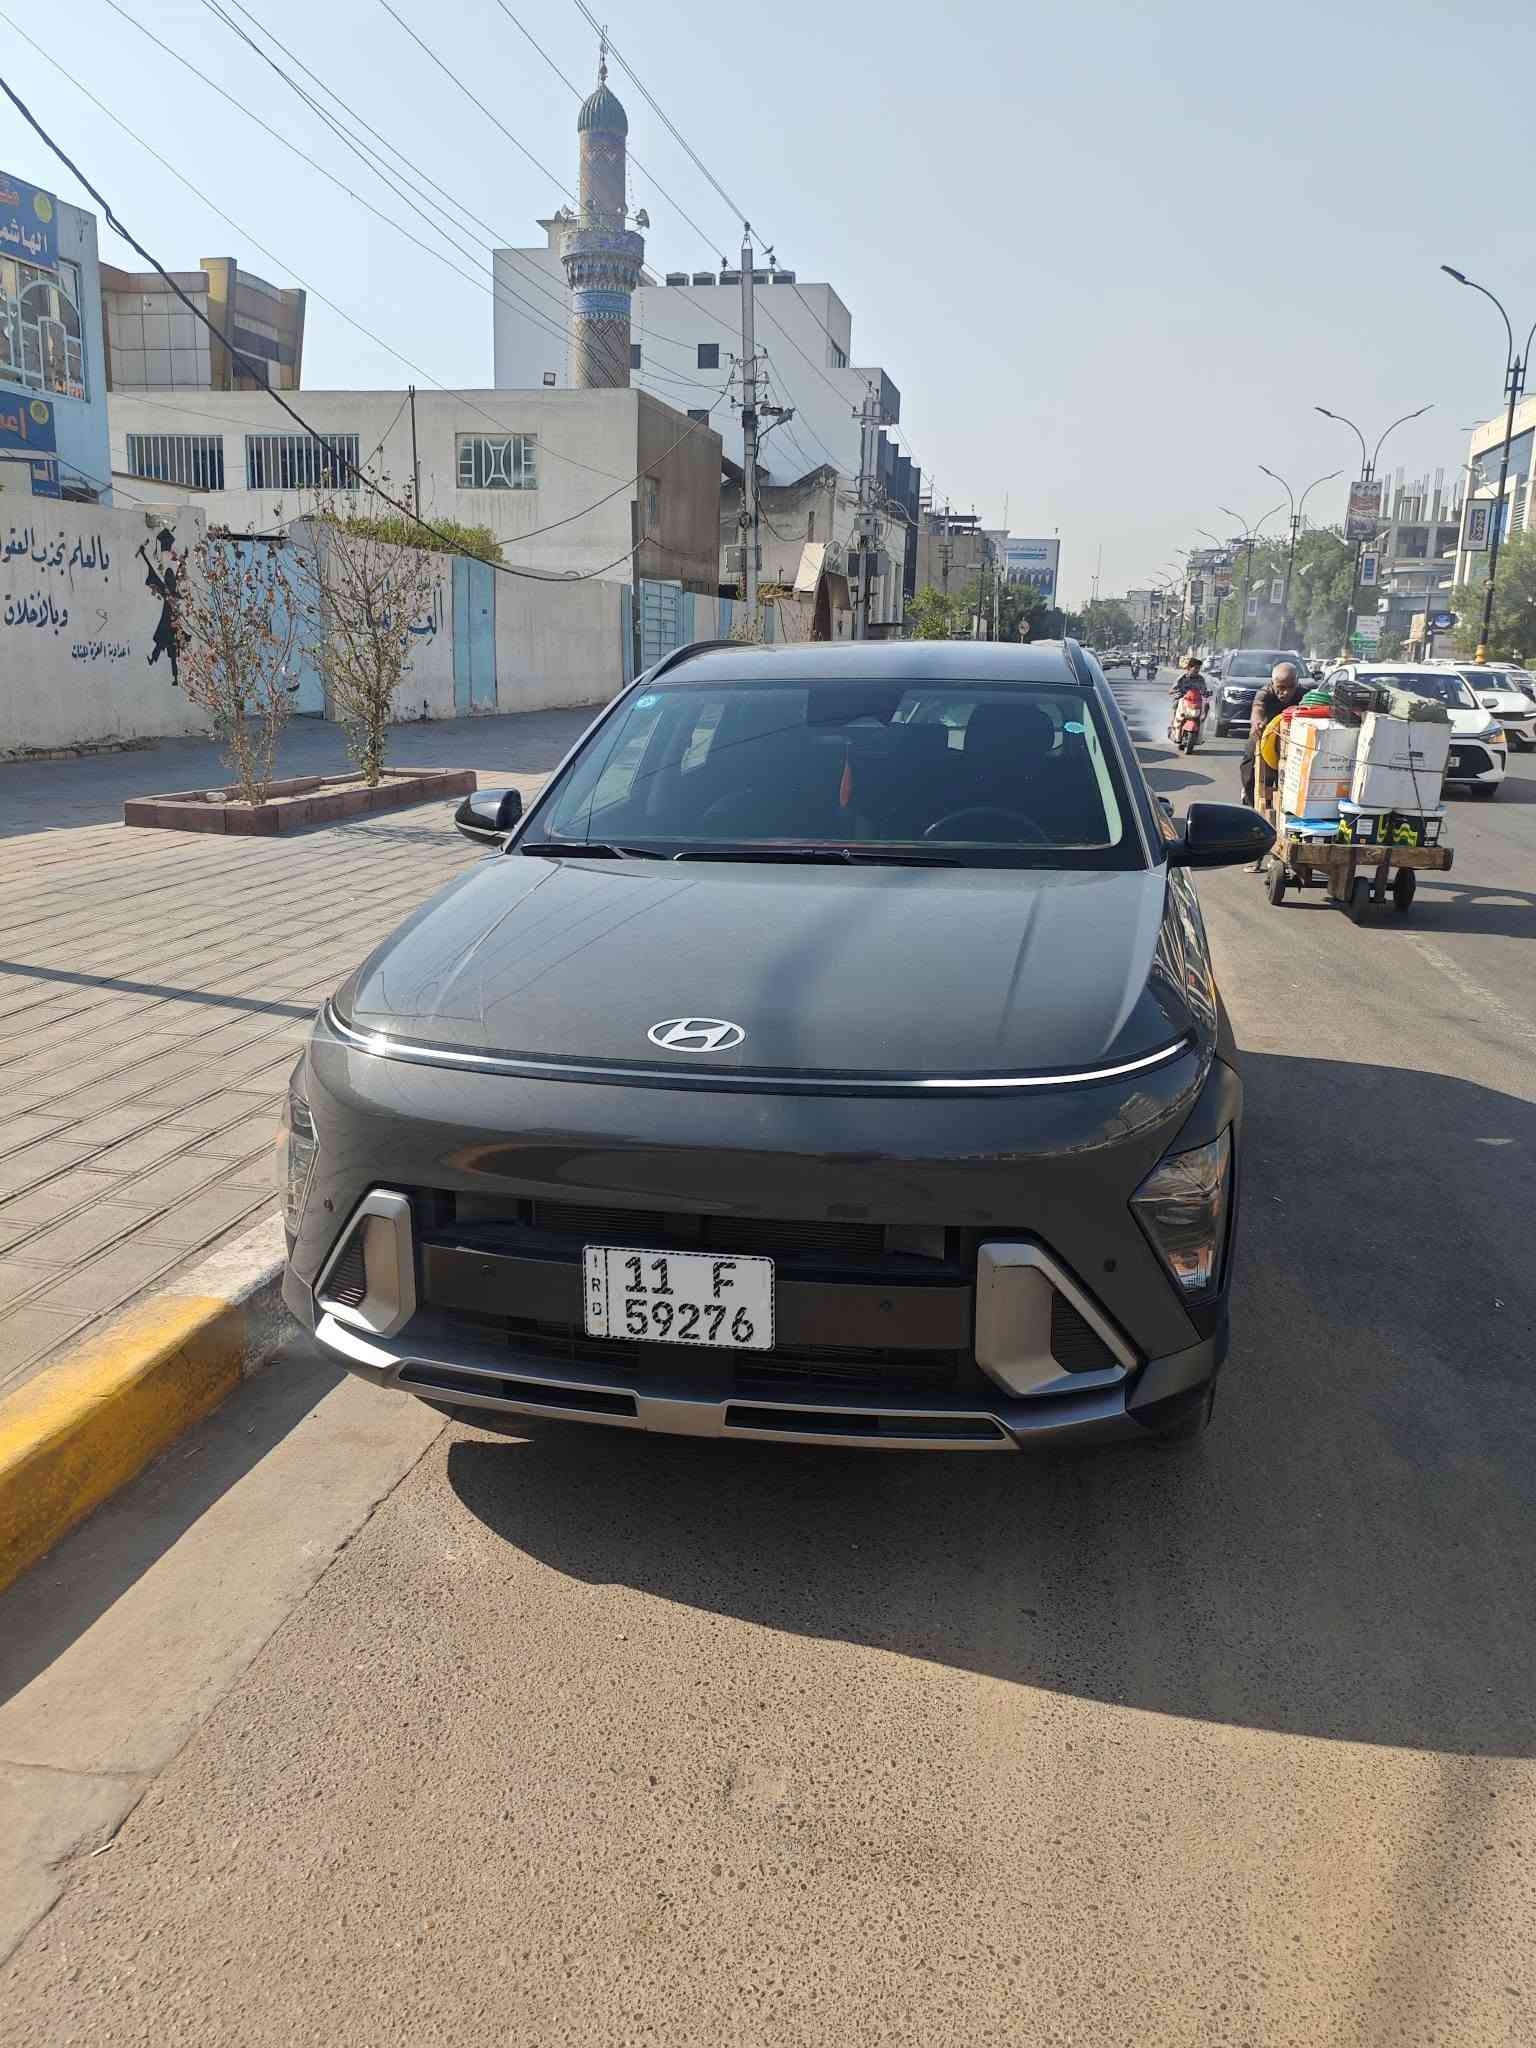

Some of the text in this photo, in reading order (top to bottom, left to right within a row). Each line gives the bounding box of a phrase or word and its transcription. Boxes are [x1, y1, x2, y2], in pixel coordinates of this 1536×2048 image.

[0, 526, 35, 563] العقو
[69, 534, 110, 592] بالعلم
[624, 1256, 737, 1298] 11 F
[625, 1298, 755, 1343] 59276
